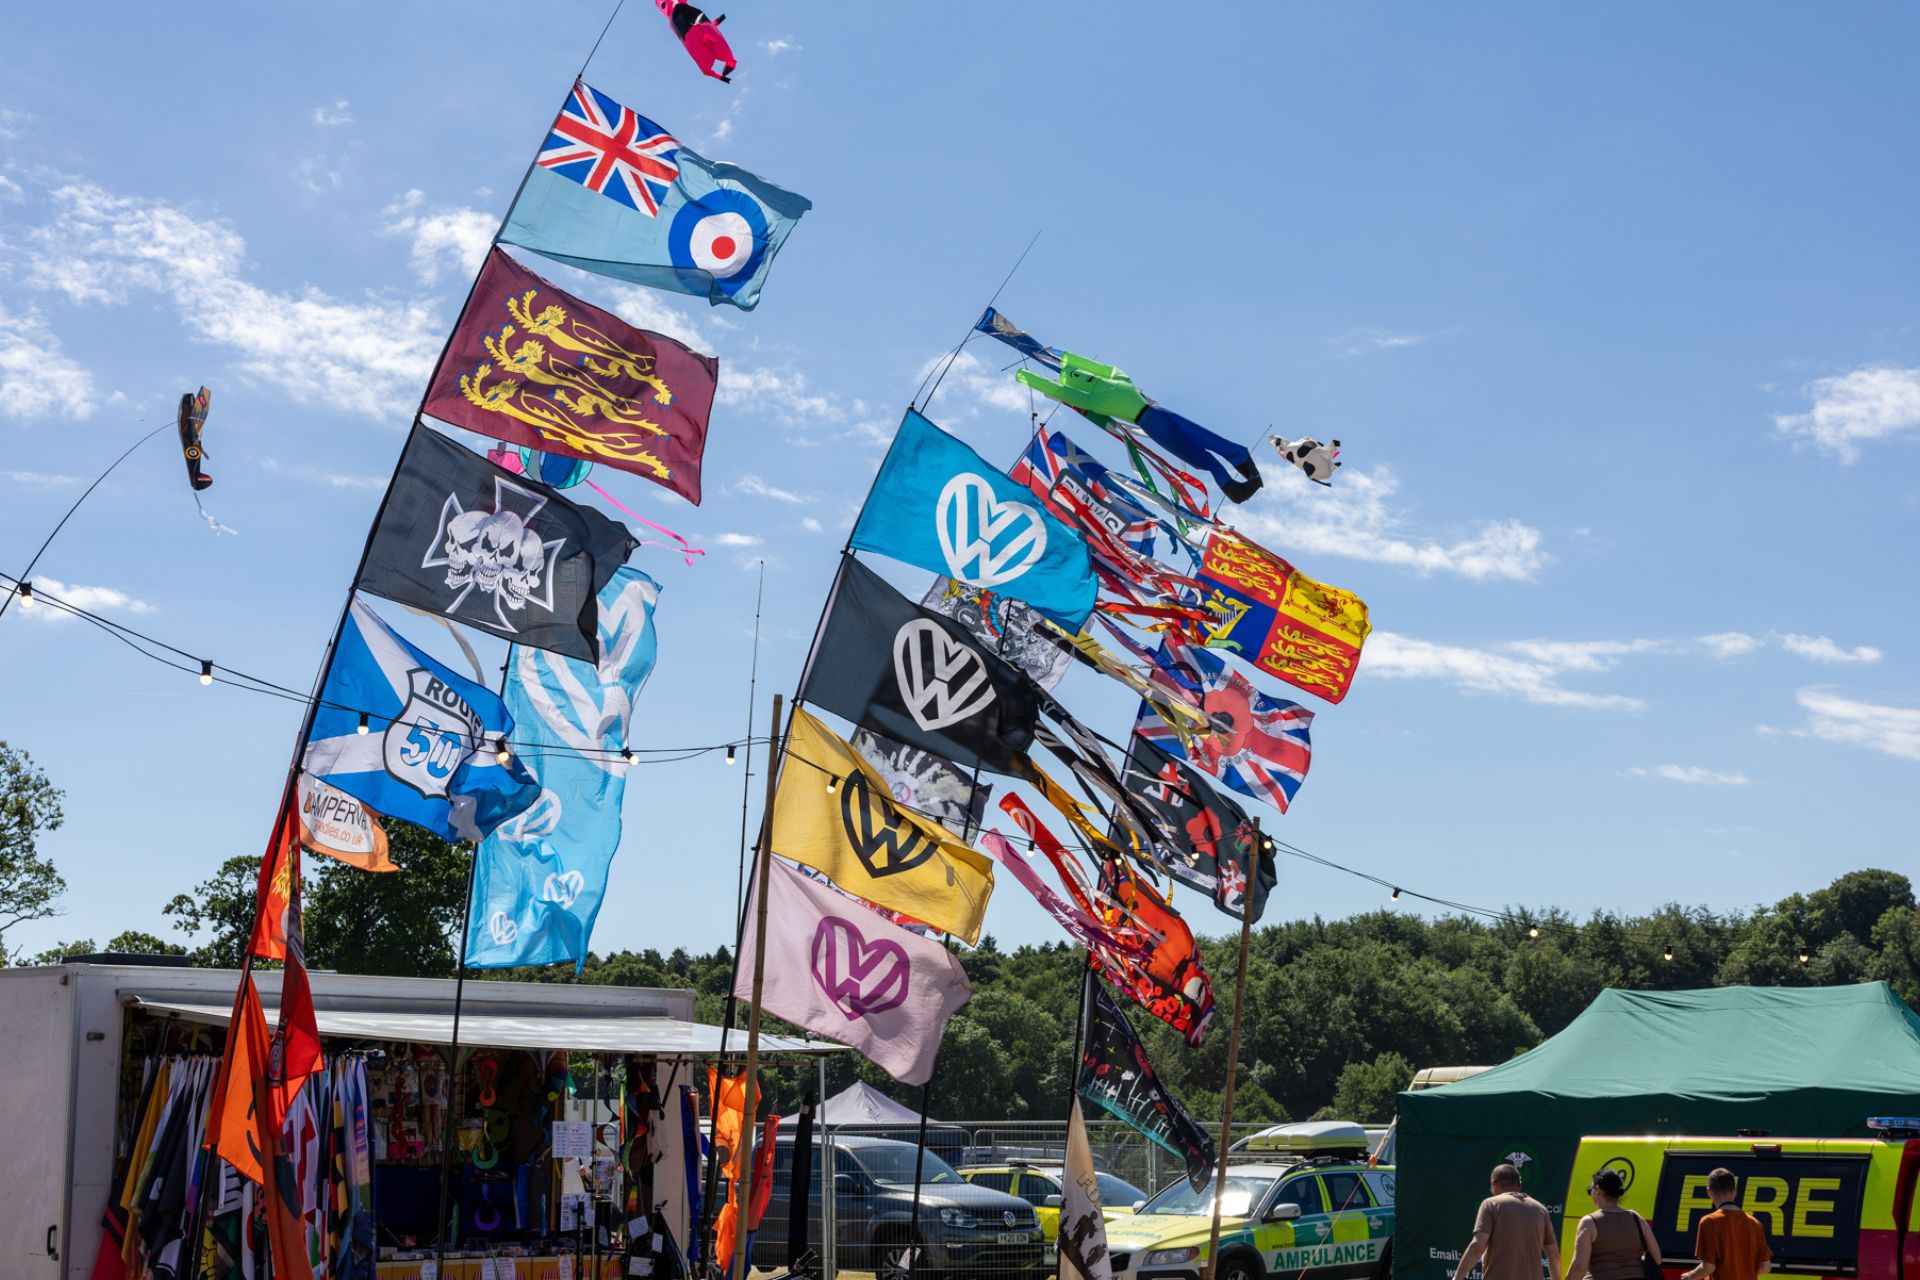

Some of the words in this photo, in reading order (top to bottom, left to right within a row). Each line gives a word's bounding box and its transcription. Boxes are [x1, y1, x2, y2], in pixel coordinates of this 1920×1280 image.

[400, 716, 462, 778] 50
[1676, 1174, 1842, 1238] FRE
[1273, 1243, 1376, 1270] AMBULANCE
[1429, 1247, 1462, 1261] Email:
